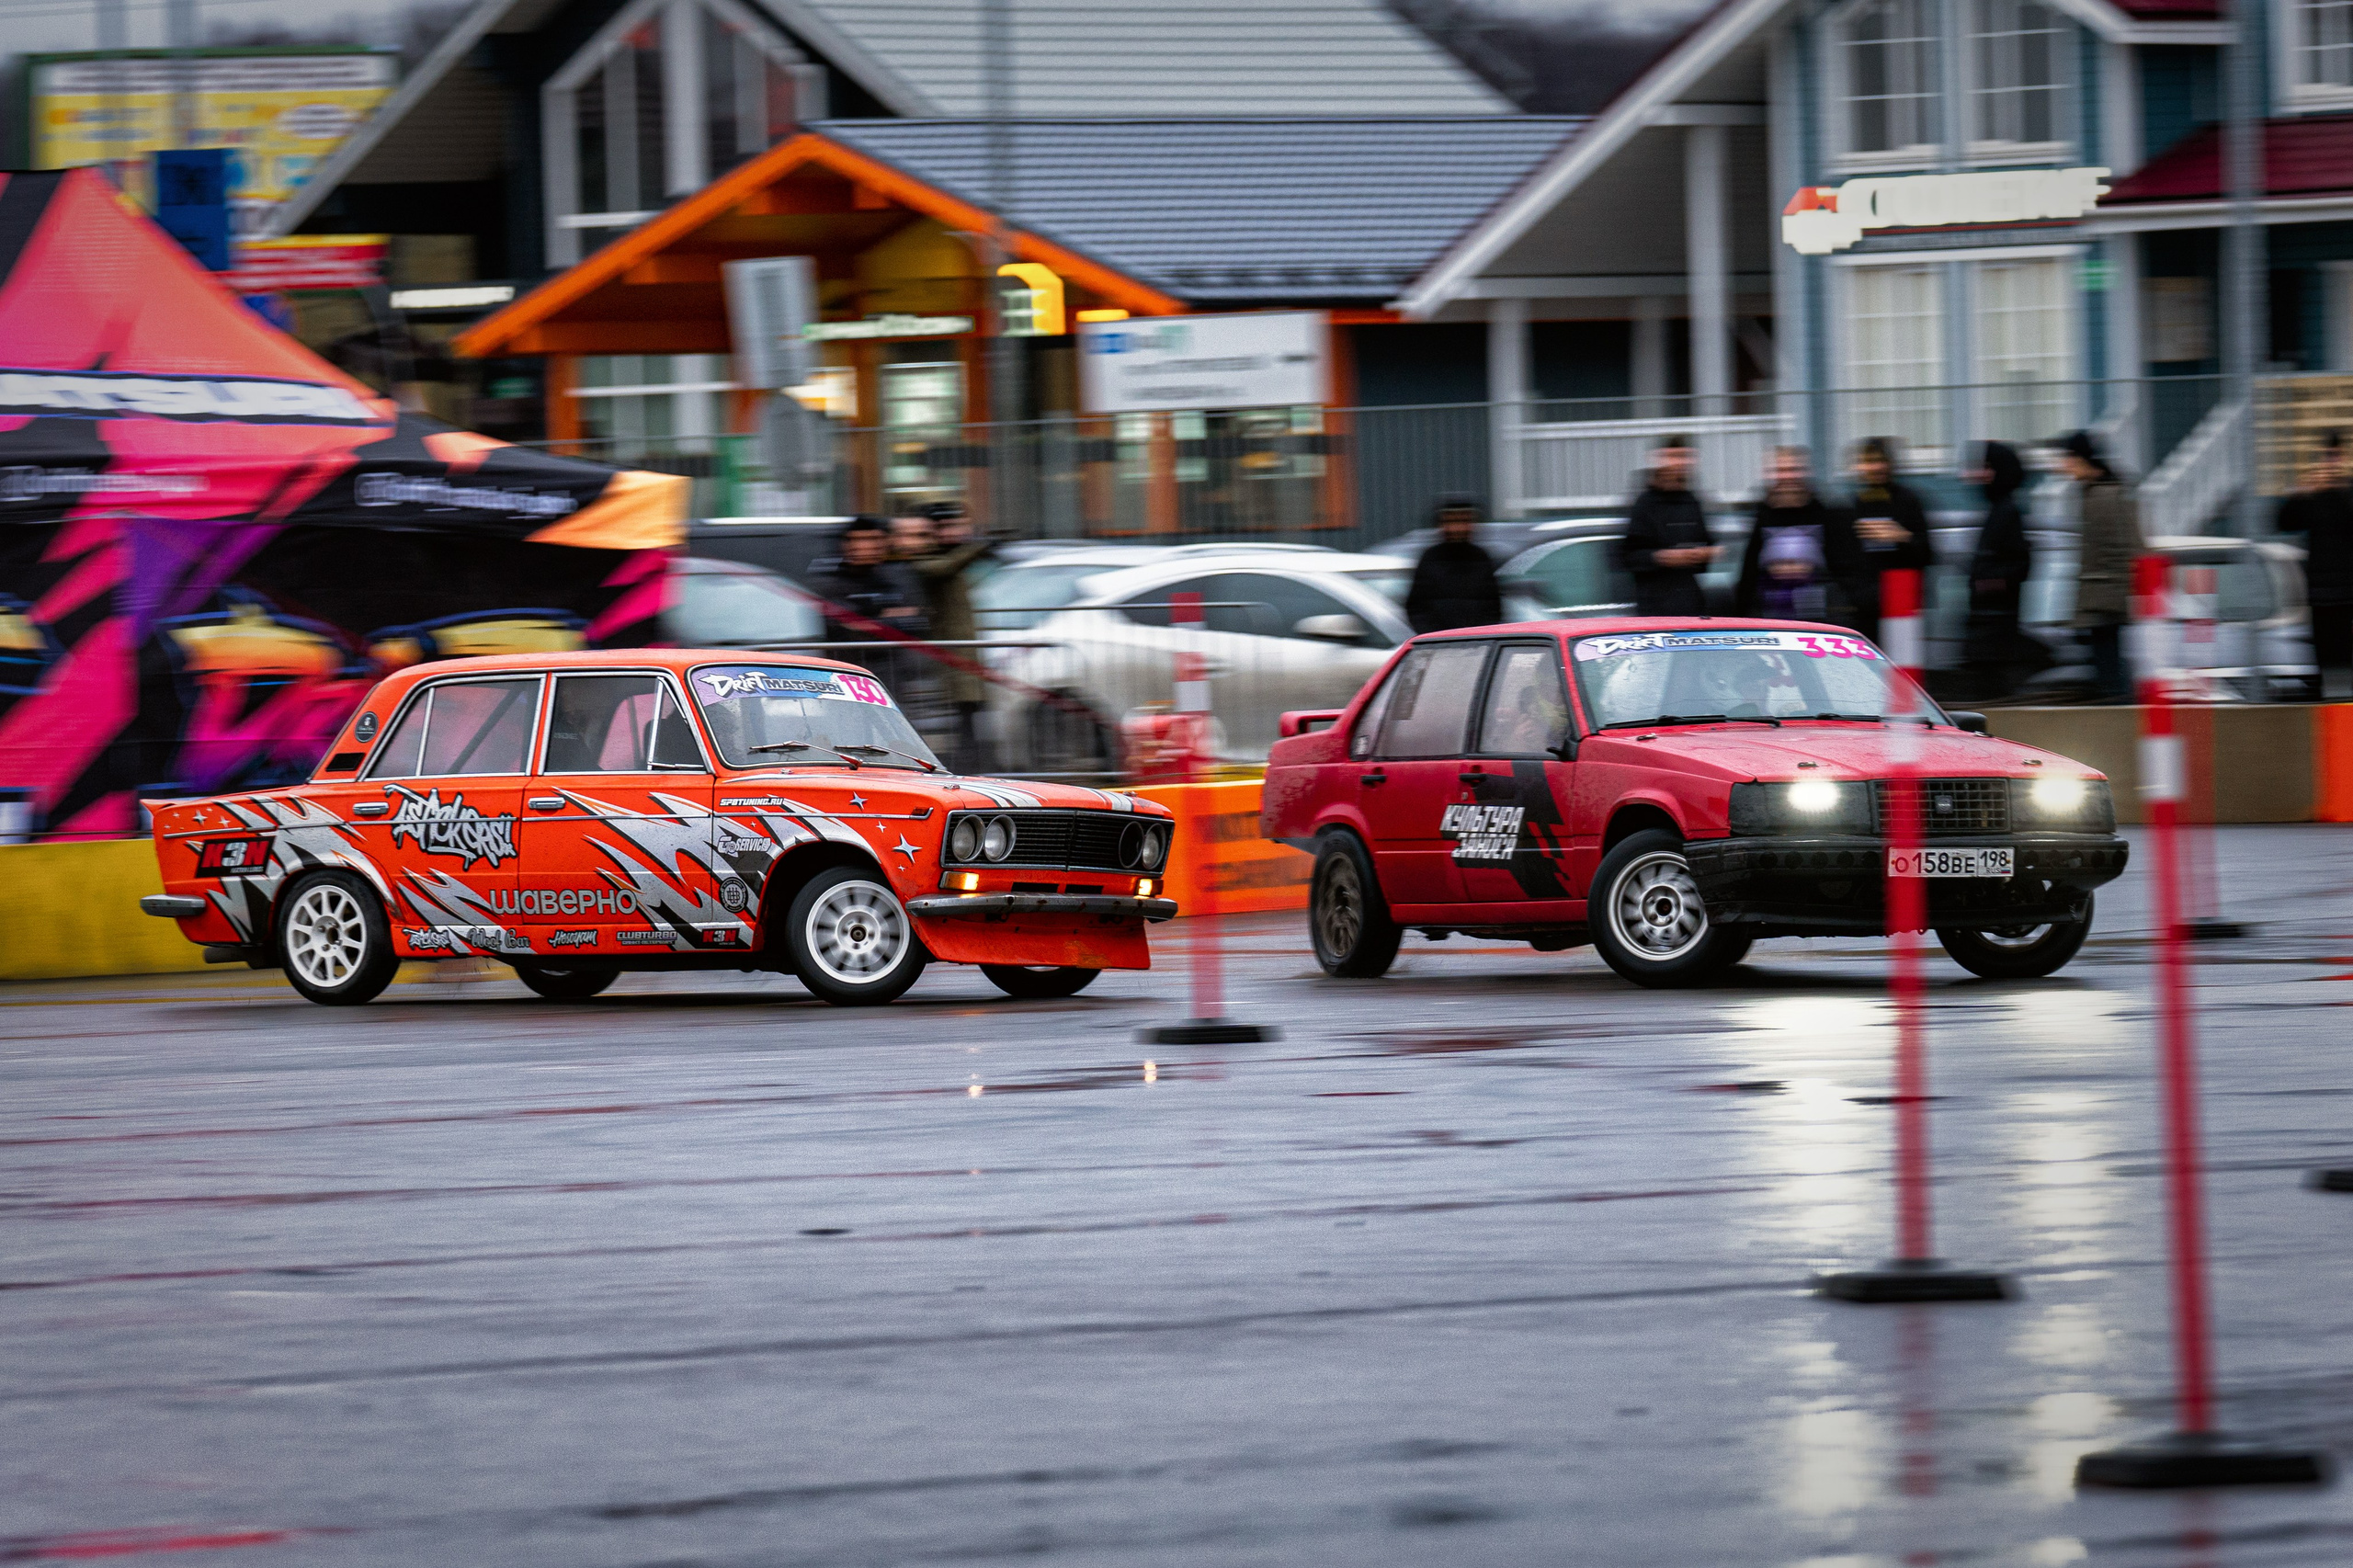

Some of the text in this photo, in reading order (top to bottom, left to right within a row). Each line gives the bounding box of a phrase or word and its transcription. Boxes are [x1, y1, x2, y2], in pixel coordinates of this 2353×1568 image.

[1665, 636, 1781, 648] MATSURI
[1798, 636, 1878, 660] 333
[837, 674, 888, 706] 130
[1439, 804, 1525, 834] КУЛЬТУРА
[1980, 850, 2007, 867] 198
[505, 928, 531, 949] Bar
[617, 931, 677, 939] CLUBTURBO
